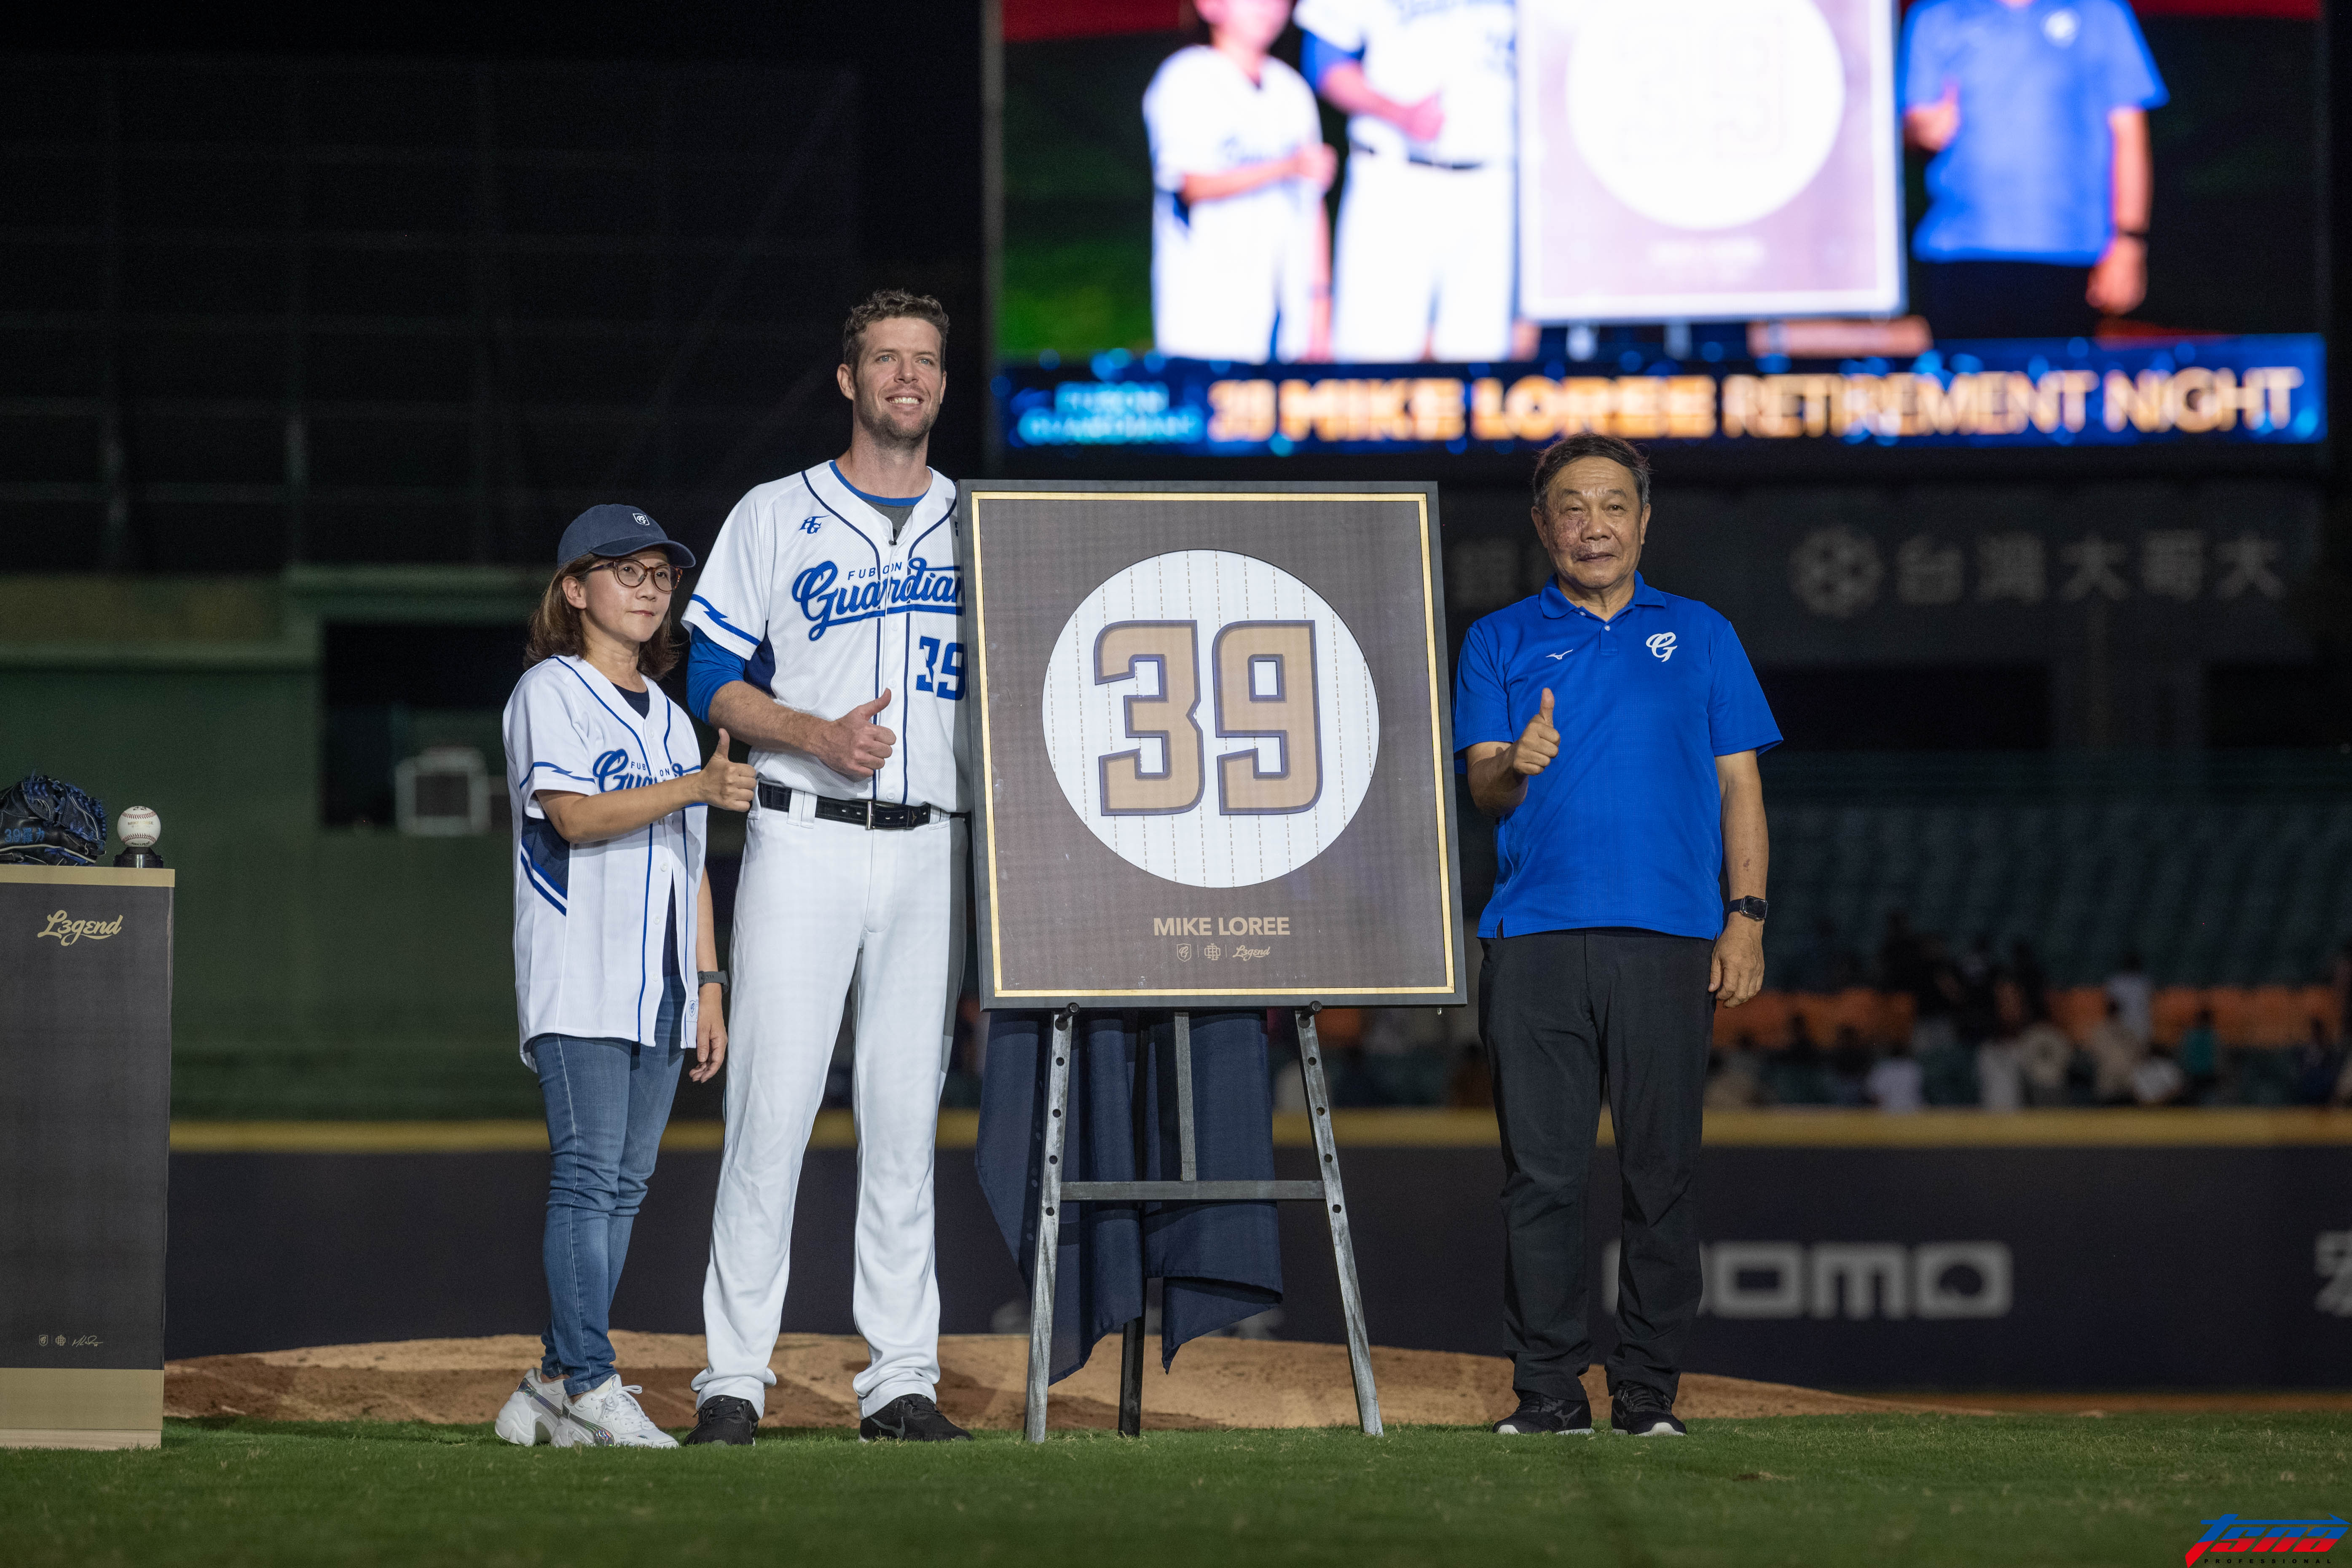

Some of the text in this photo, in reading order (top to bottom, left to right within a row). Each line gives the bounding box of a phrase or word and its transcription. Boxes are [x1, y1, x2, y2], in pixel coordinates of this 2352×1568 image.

[1279, 378, 1465, 441] MIKE
[1722, 368, 2099, 438] RETIREMENT
[2103, 367, 2304, 433] NIGHT
[792, 558, 963, 641] Guardia
[848, 562, 902, 580] FUBON
[916, 635, 965, 700] 39
[1094, 619, 1323, 816] 39
[1153, 917, 1290, 936] MIKE LOREE
